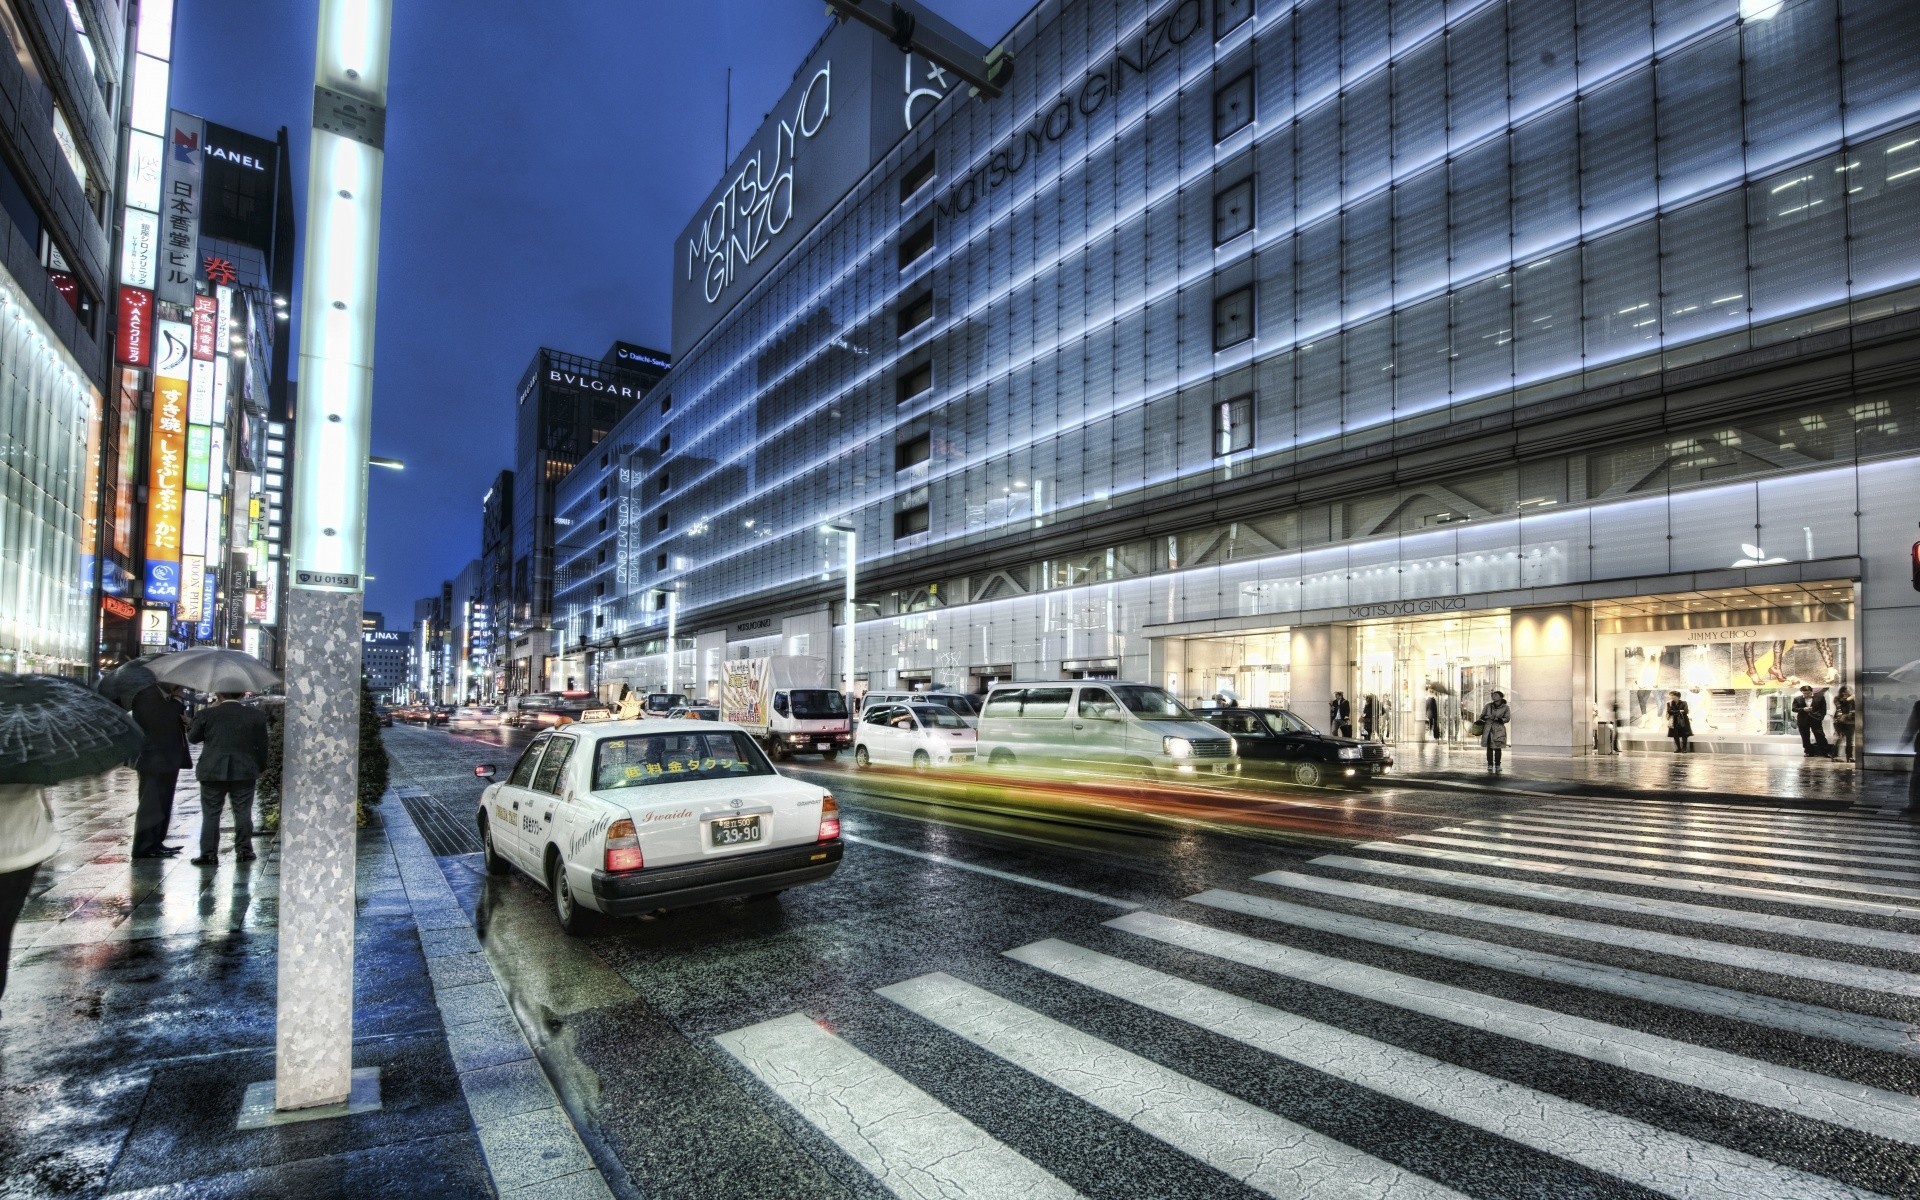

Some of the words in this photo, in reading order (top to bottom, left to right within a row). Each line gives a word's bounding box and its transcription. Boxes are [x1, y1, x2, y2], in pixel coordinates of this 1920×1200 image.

[168, 181, 193, 285] 日本香堂ビル
[550, 370, 641, 400] BVLGARI
[325, 576, 349, 585] 0153
[201, 579, 214, 636] CHAUMET
[375, 631, 399, 640] INAX
[1688, 631, 1719, 641] JIMMY
[1720, 629, 1757, 639] CHOO
[624, 758, 750, 779] 低料金タクシー
[737, 818, 751, 827] 500
